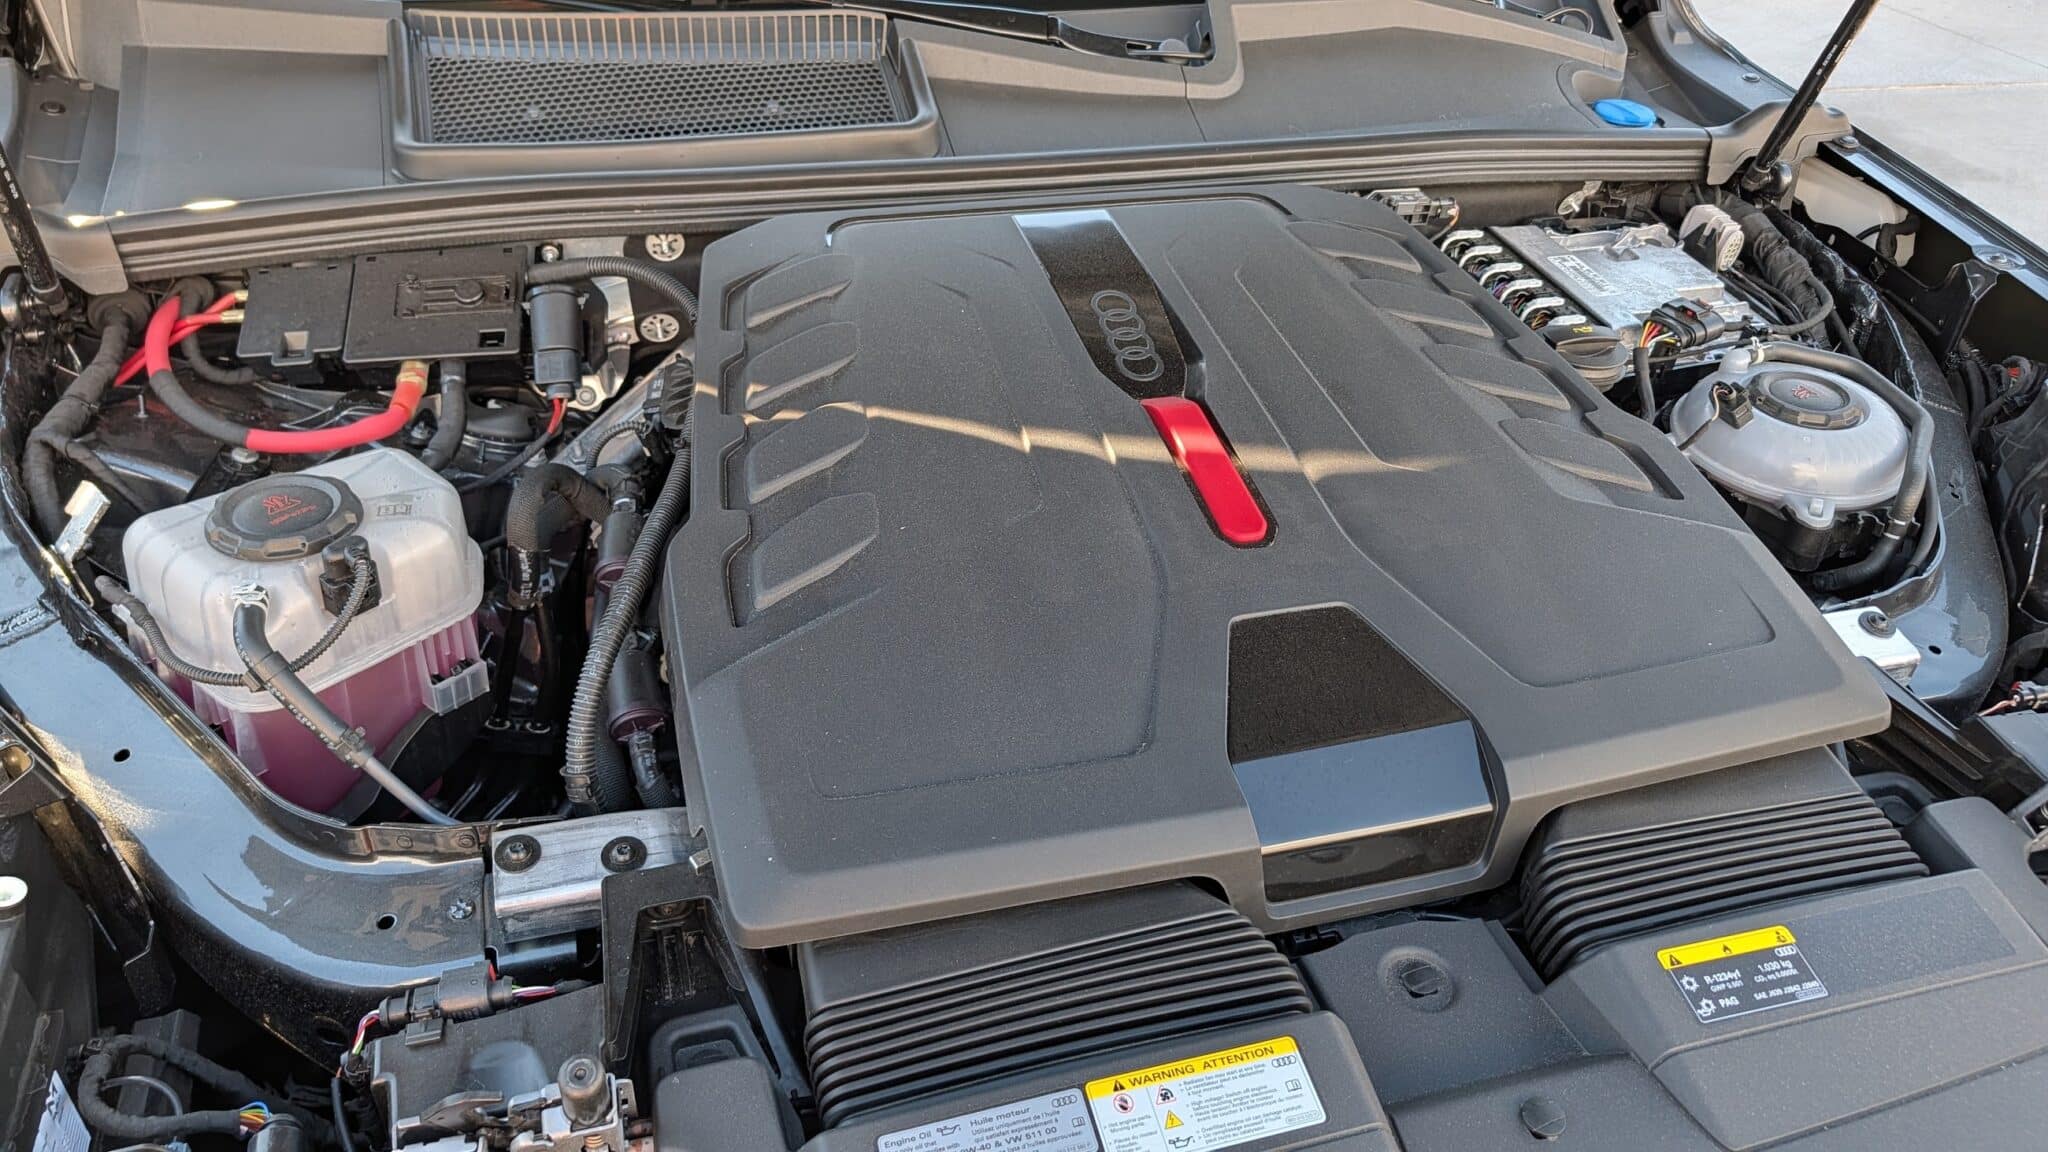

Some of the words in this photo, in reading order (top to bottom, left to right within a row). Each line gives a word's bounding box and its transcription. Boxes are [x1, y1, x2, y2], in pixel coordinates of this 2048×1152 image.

[1781, 960, 1793, 969] kg
[1719, 996, 1740, 1008] PAG
[1128, 1064, 1195, 1087] WARNING
[1203, 1046, 1275, 1071] ATTENTION
[970, 1117, 993, 1127] Huile
[996, 1107, 1030, 1121] moteur
[884, 1136, 916, 1149] Engine
[919, 1131, 932, 1140] Oil
[960, 1143, 992, 1152] W-40
[995, 1141, 1003, 1149] &
[1004, 1134, 1023, 1145] VW
[1025, 1130, 1042, 1140] 511
[1045, 1126, 1057, 1135] 00
